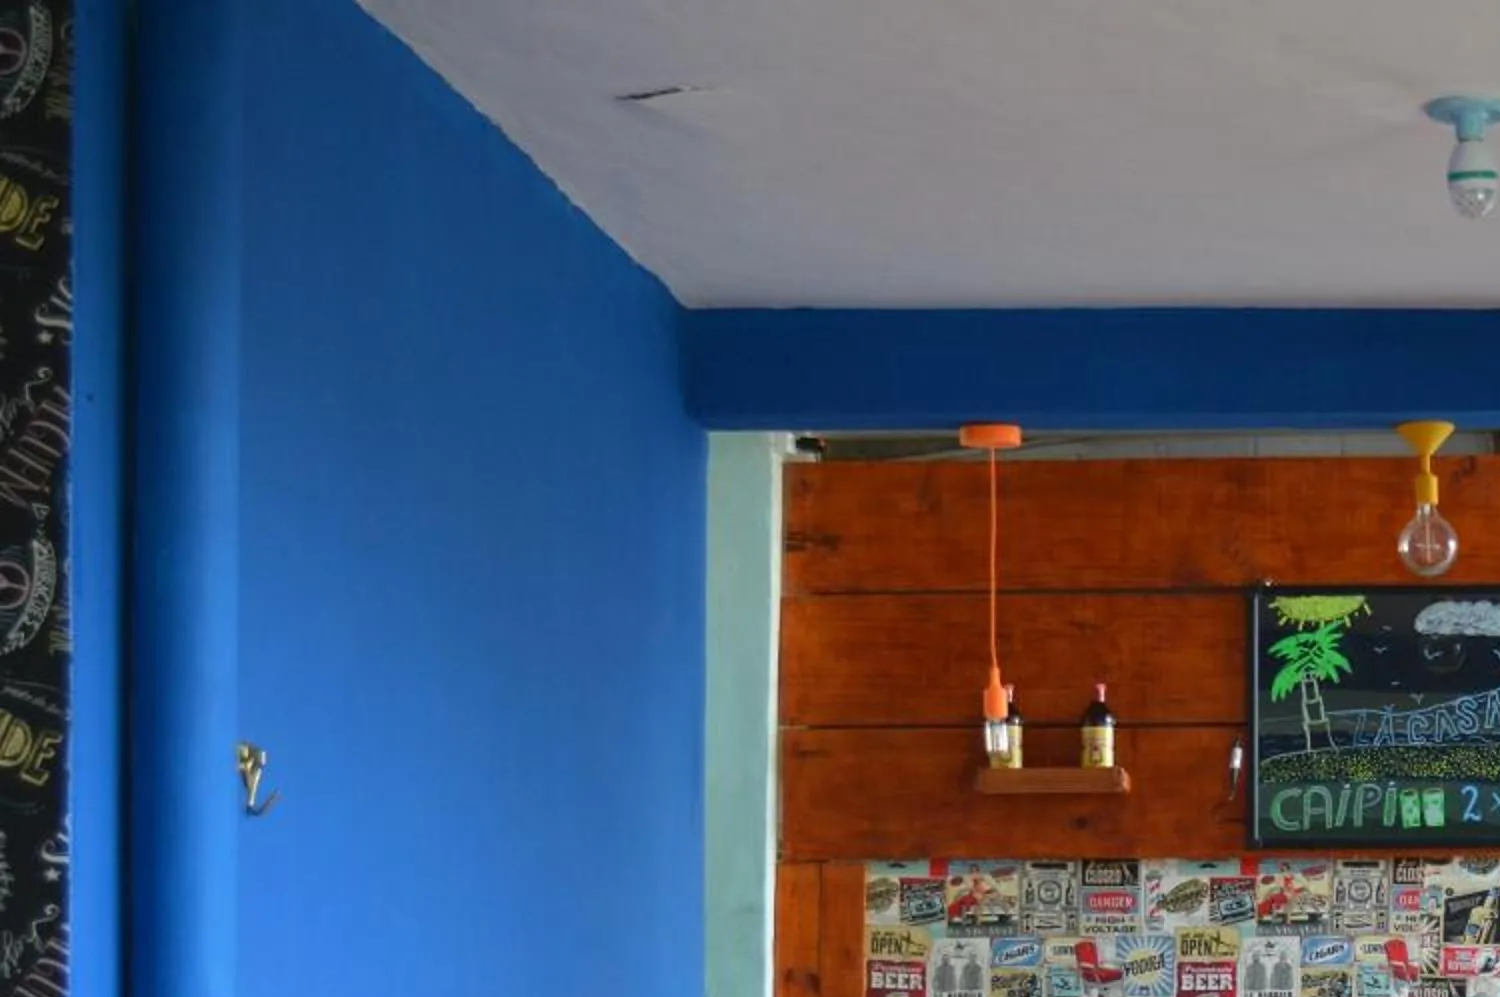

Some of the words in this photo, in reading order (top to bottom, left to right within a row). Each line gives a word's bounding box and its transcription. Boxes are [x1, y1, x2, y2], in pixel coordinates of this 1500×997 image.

[1461, 785, 1482, 821] 2
[1089, 895, 1133, 908] DANGER
[871, 936, 903, 955] OPEN
[1181, 939, 1213, 956] OPEN
[871, 971, 923, 989] BEER
[1181, 973, 1233, 990] BEER
